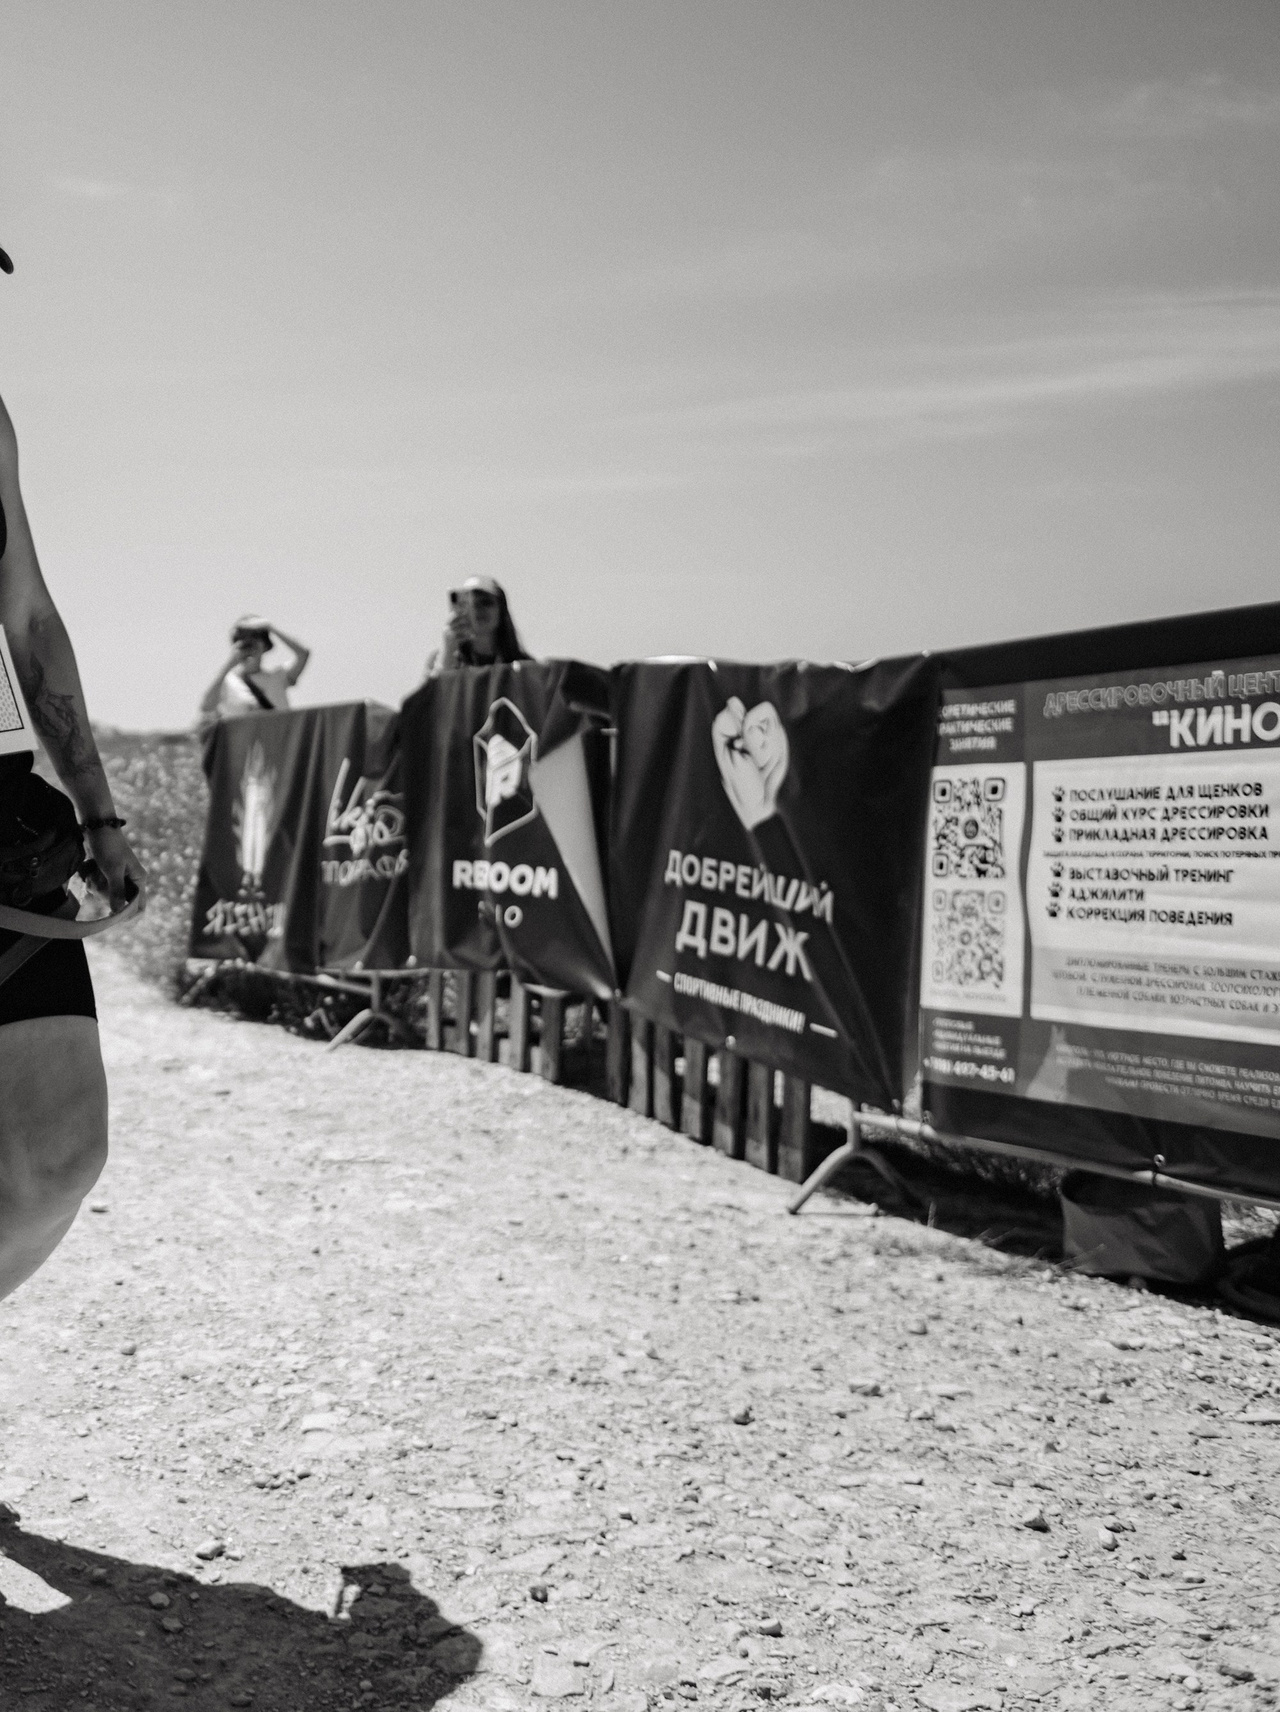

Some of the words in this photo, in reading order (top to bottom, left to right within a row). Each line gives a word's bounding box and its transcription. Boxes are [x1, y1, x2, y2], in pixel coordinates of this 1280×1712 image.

[1043, 670, 1227, 718] ДРЕССИРОВОЧНЫЙ
[1070, 786, 1161, 801] ПОСЛУШАНИЕ
[1165, 785, 1194, 800] ДЛЯ
[1198, 782, 1263, 800] ЩЕНКОВ
[1069, 803, 1117, 822] ОБЩИЙ
[1121, 807, 1157, 820] КУРС
[1160, 804, 1269, 821] ДРЕССИРОВКИ
[1069, 827, 1156, 842] ПРИКЛАДНАЯ
[1160, 825, 1268, 842] ДРЕССИРОВКА
[1069, 864, 1169, 882] ВЫСТАВОЧНЫЙ
[1173, 868, 1234, 883] ТРЕНИНГ
[664, 849, 835, 925] ДОБРЕЙШИЙ
[1068, 887, 1145, 901] АДЖИЛИТИ
[1067, 907, 1145, 923] КОРРЕКЦИЯ
[1149, 909, 1234, 927] ПОВЕДЕНИЯ
[674, 900, 815, 982] ДВИЖ
[1250, 969, 1280, 981] СТАЖ
[674, 972, 740, 1012] СПОРТИВНЫЕ
[1209, 982, 1280, 997] ЗООПСИХОЛОГ
